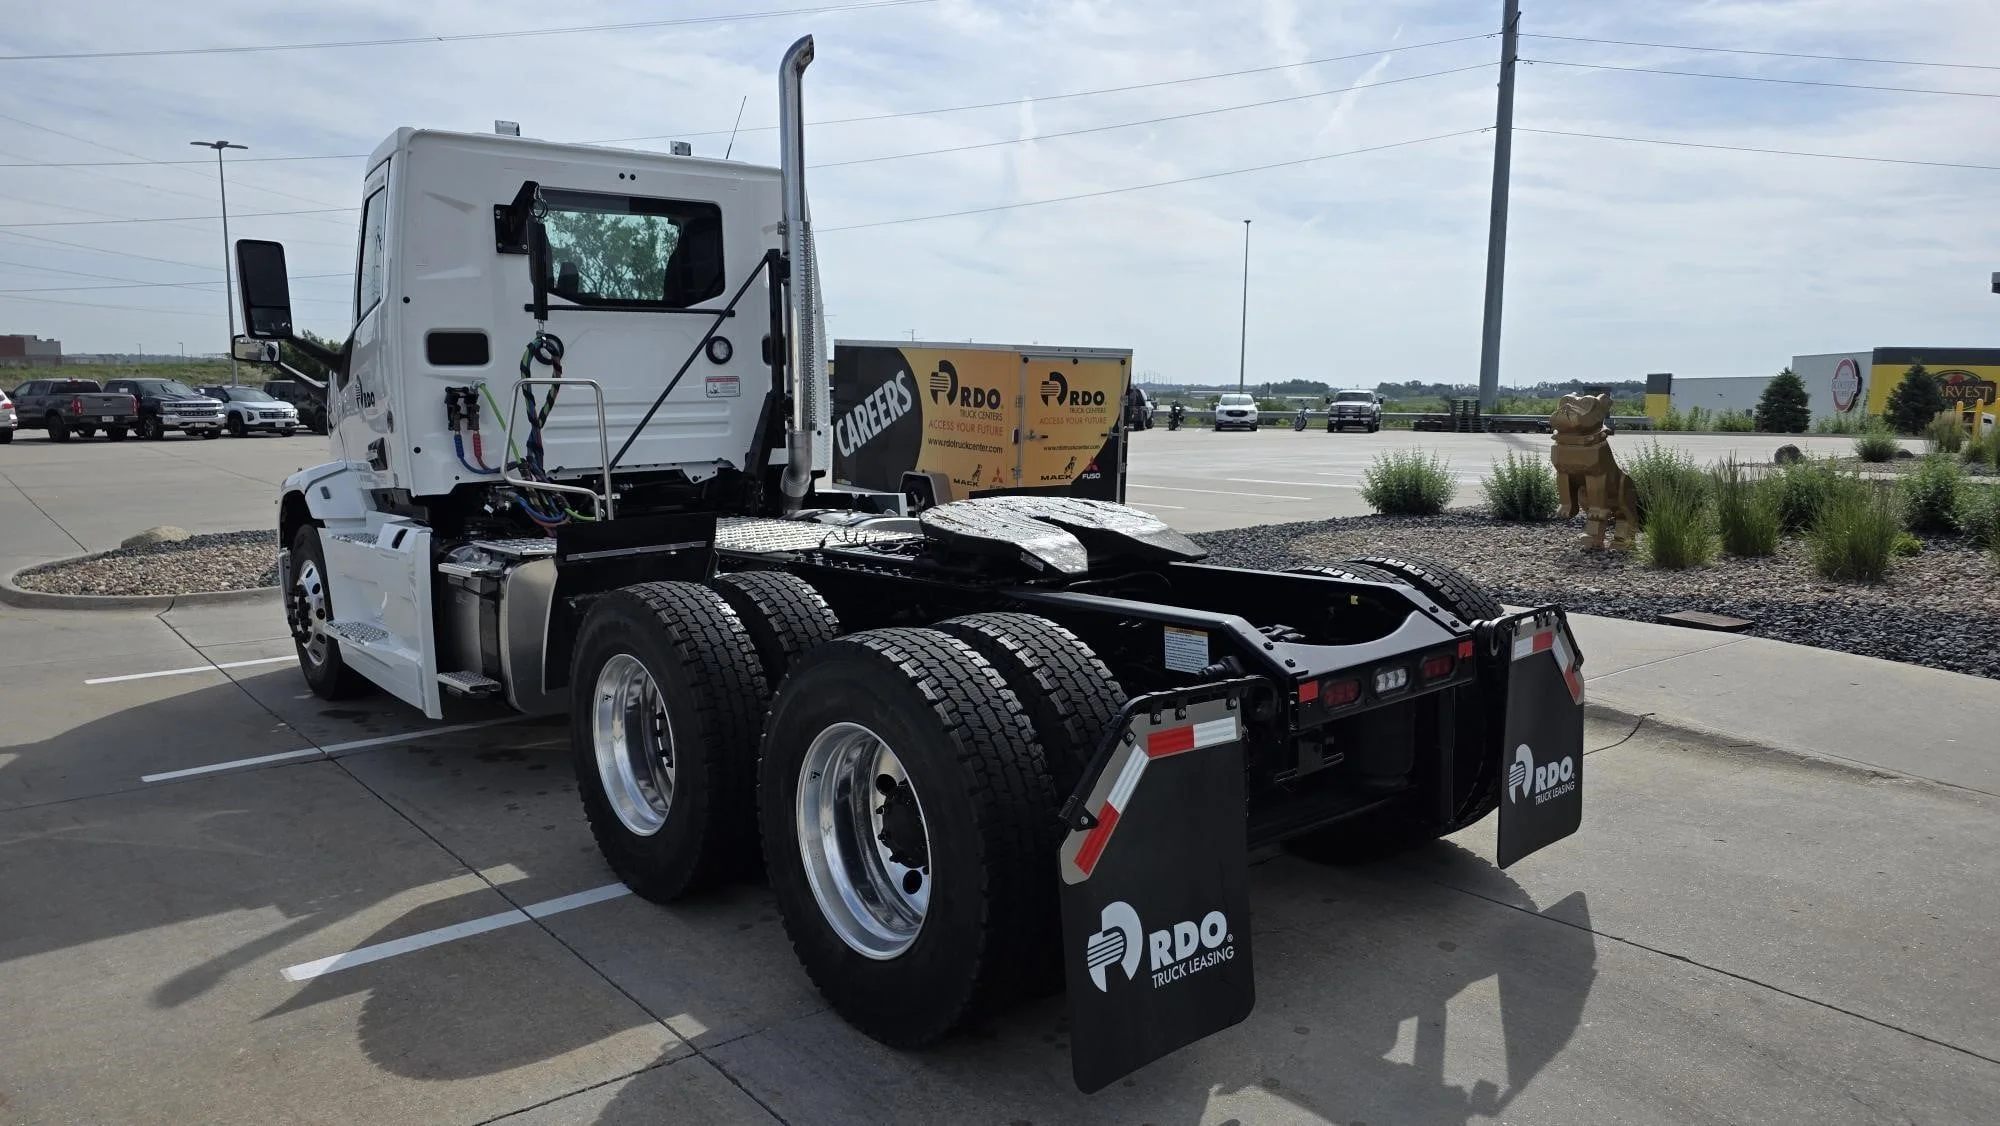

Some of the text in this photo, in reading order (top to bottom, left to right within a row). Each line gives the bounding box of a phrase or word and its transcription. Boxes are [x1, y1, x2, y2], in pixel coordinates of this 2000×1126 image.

[836, 370, 912, 457] CAREERS
[960, 409, 1003, 421] TRUCK CENTERS
[1040, 416, 1107, 425] ACCESS YOUR FUTURE
[928, 420, 1003, 436] ACCESS YOUR FUTURE
[927, 438, 1003, 454] www.rdotruckcenter.com
[953, 478, 979, 487] MACK
[1082, 472, 1101, 480] FUSO
[1535, 781, 1575, 805] TRUCK LEASING
[1151, 945, 1235, 989] TRUCK LEASING
